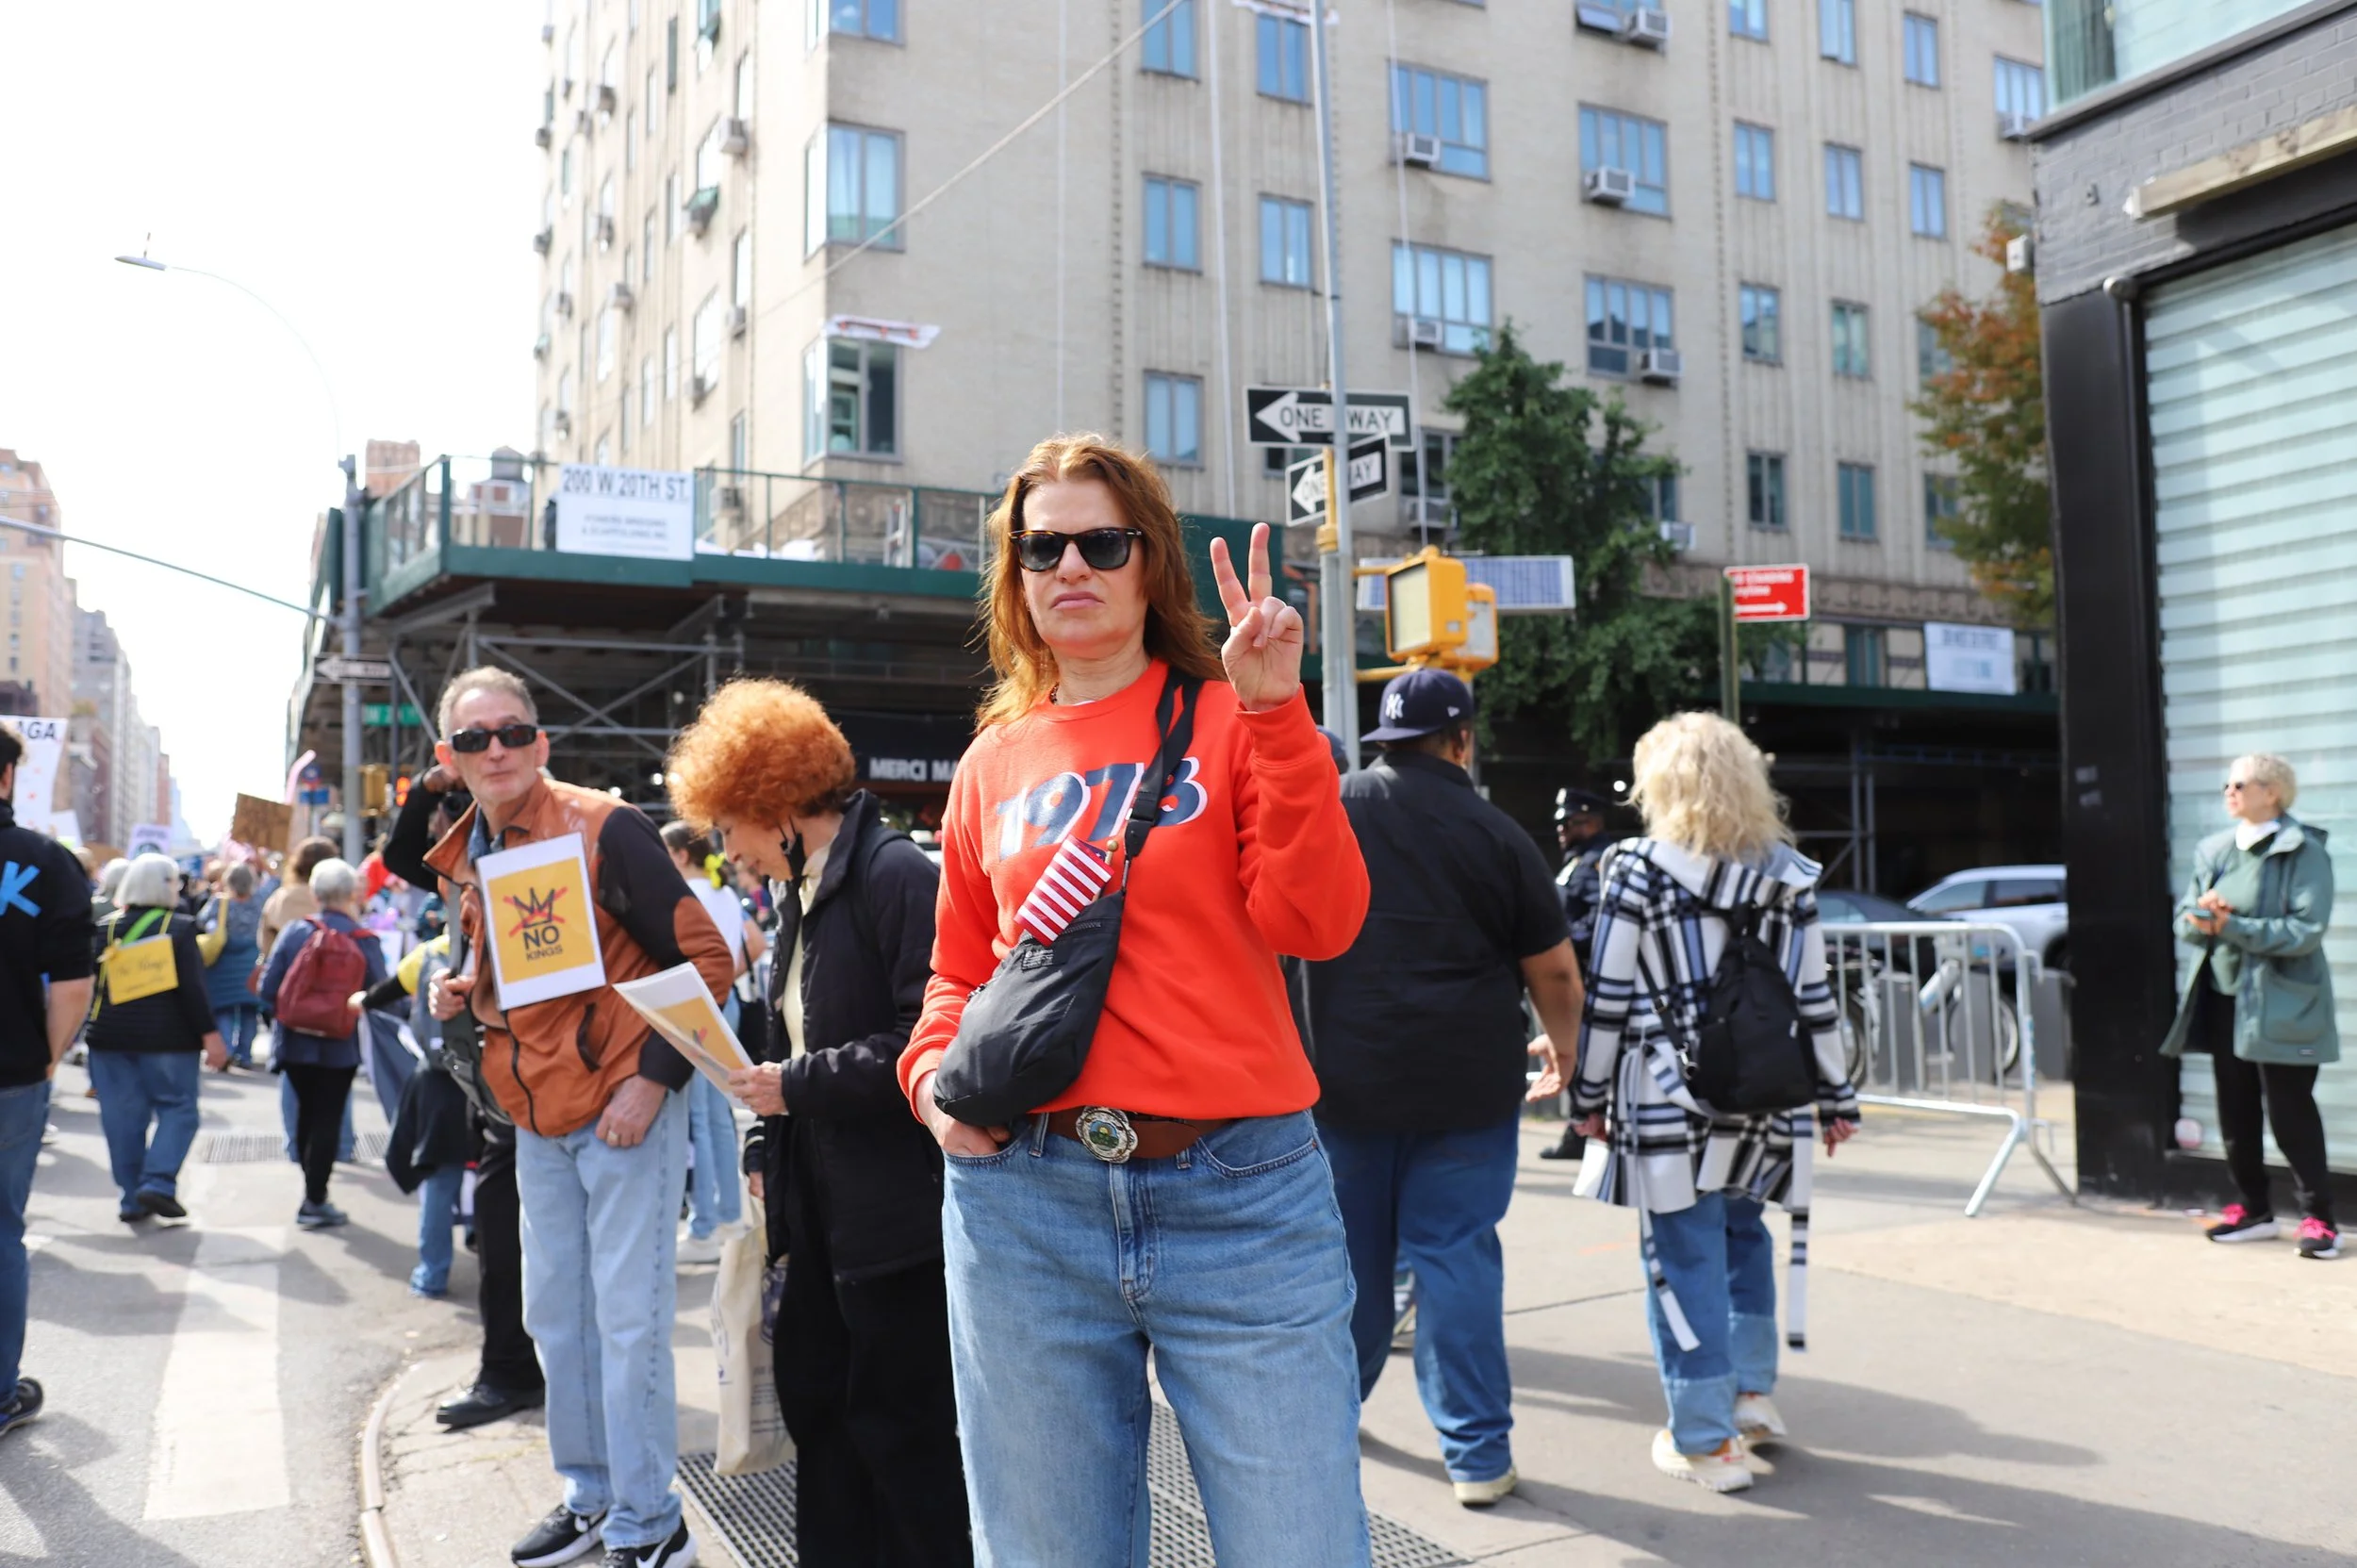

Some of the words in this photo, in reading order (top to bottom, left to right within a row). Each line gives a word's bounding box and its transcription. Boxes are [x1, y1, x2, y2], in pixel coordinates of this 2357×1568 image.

[1279, 405, 1325, 428] ONE
[1346, 408, 1393, 431] WAY
[564, 469, 591, 493] 200
[599, 471, 613, 494] W
[618, 474, 661, 499] 20TH
[1347, 459, 1374, 486] AY
[869, 757, 928, 782] MERCI
[522, 925, 560, 950] NO
[526, 944, 563, 963] KINGS
